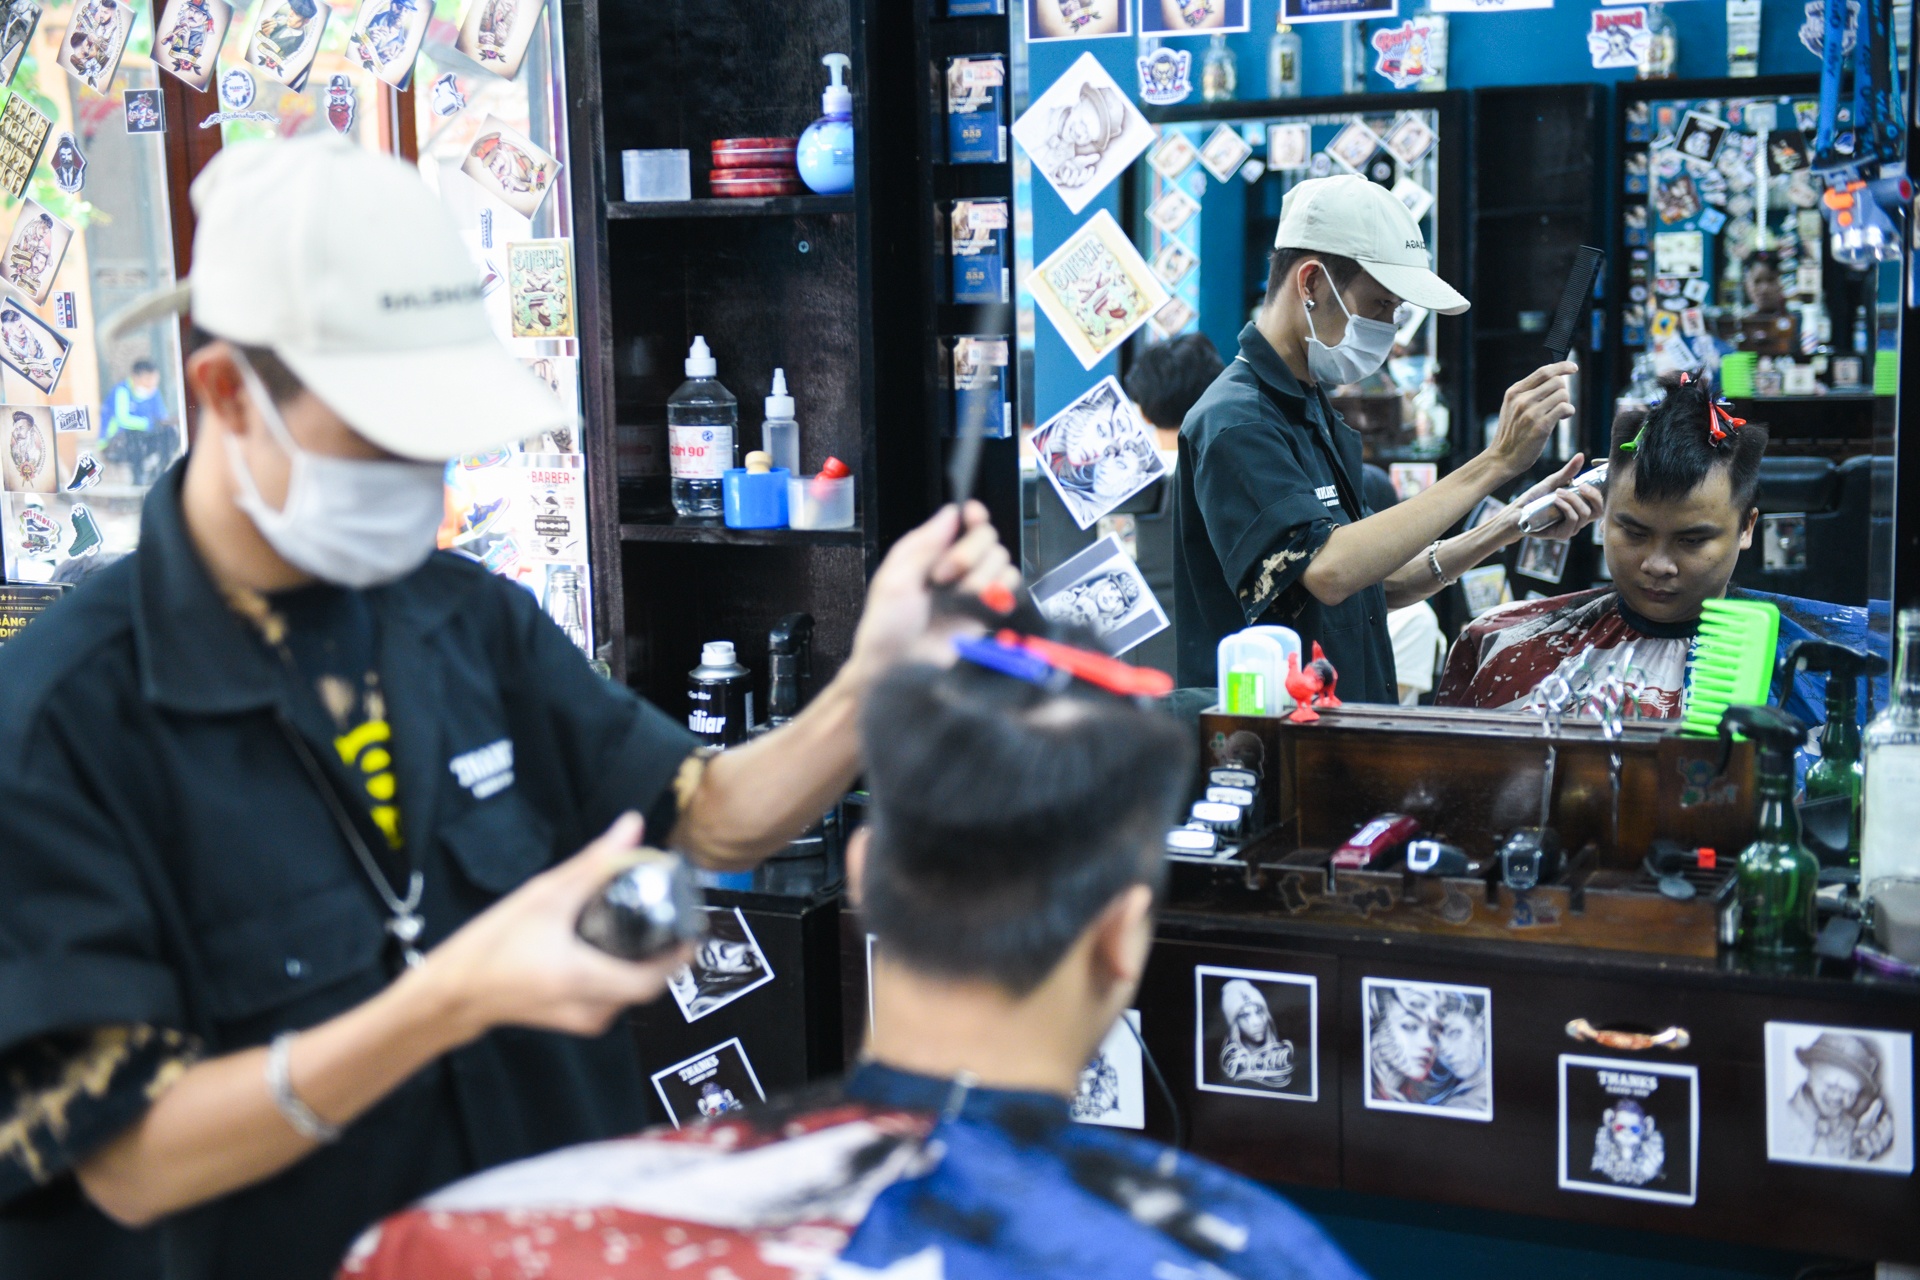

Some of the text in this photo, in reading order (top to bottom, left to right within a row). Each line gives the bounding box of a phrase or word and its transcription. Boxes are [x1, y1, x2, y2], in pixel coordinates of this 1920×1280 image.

[531, 471, 570, 484] BARBER
[33, 512, 43, 522] THE
[41, 518, 56, 530] WALL
[0, 614, 27, 626] ẢNG
[678, 1054, 719, 1082] THANKS
[1597, 1070, 1658, 1091] THANKS
